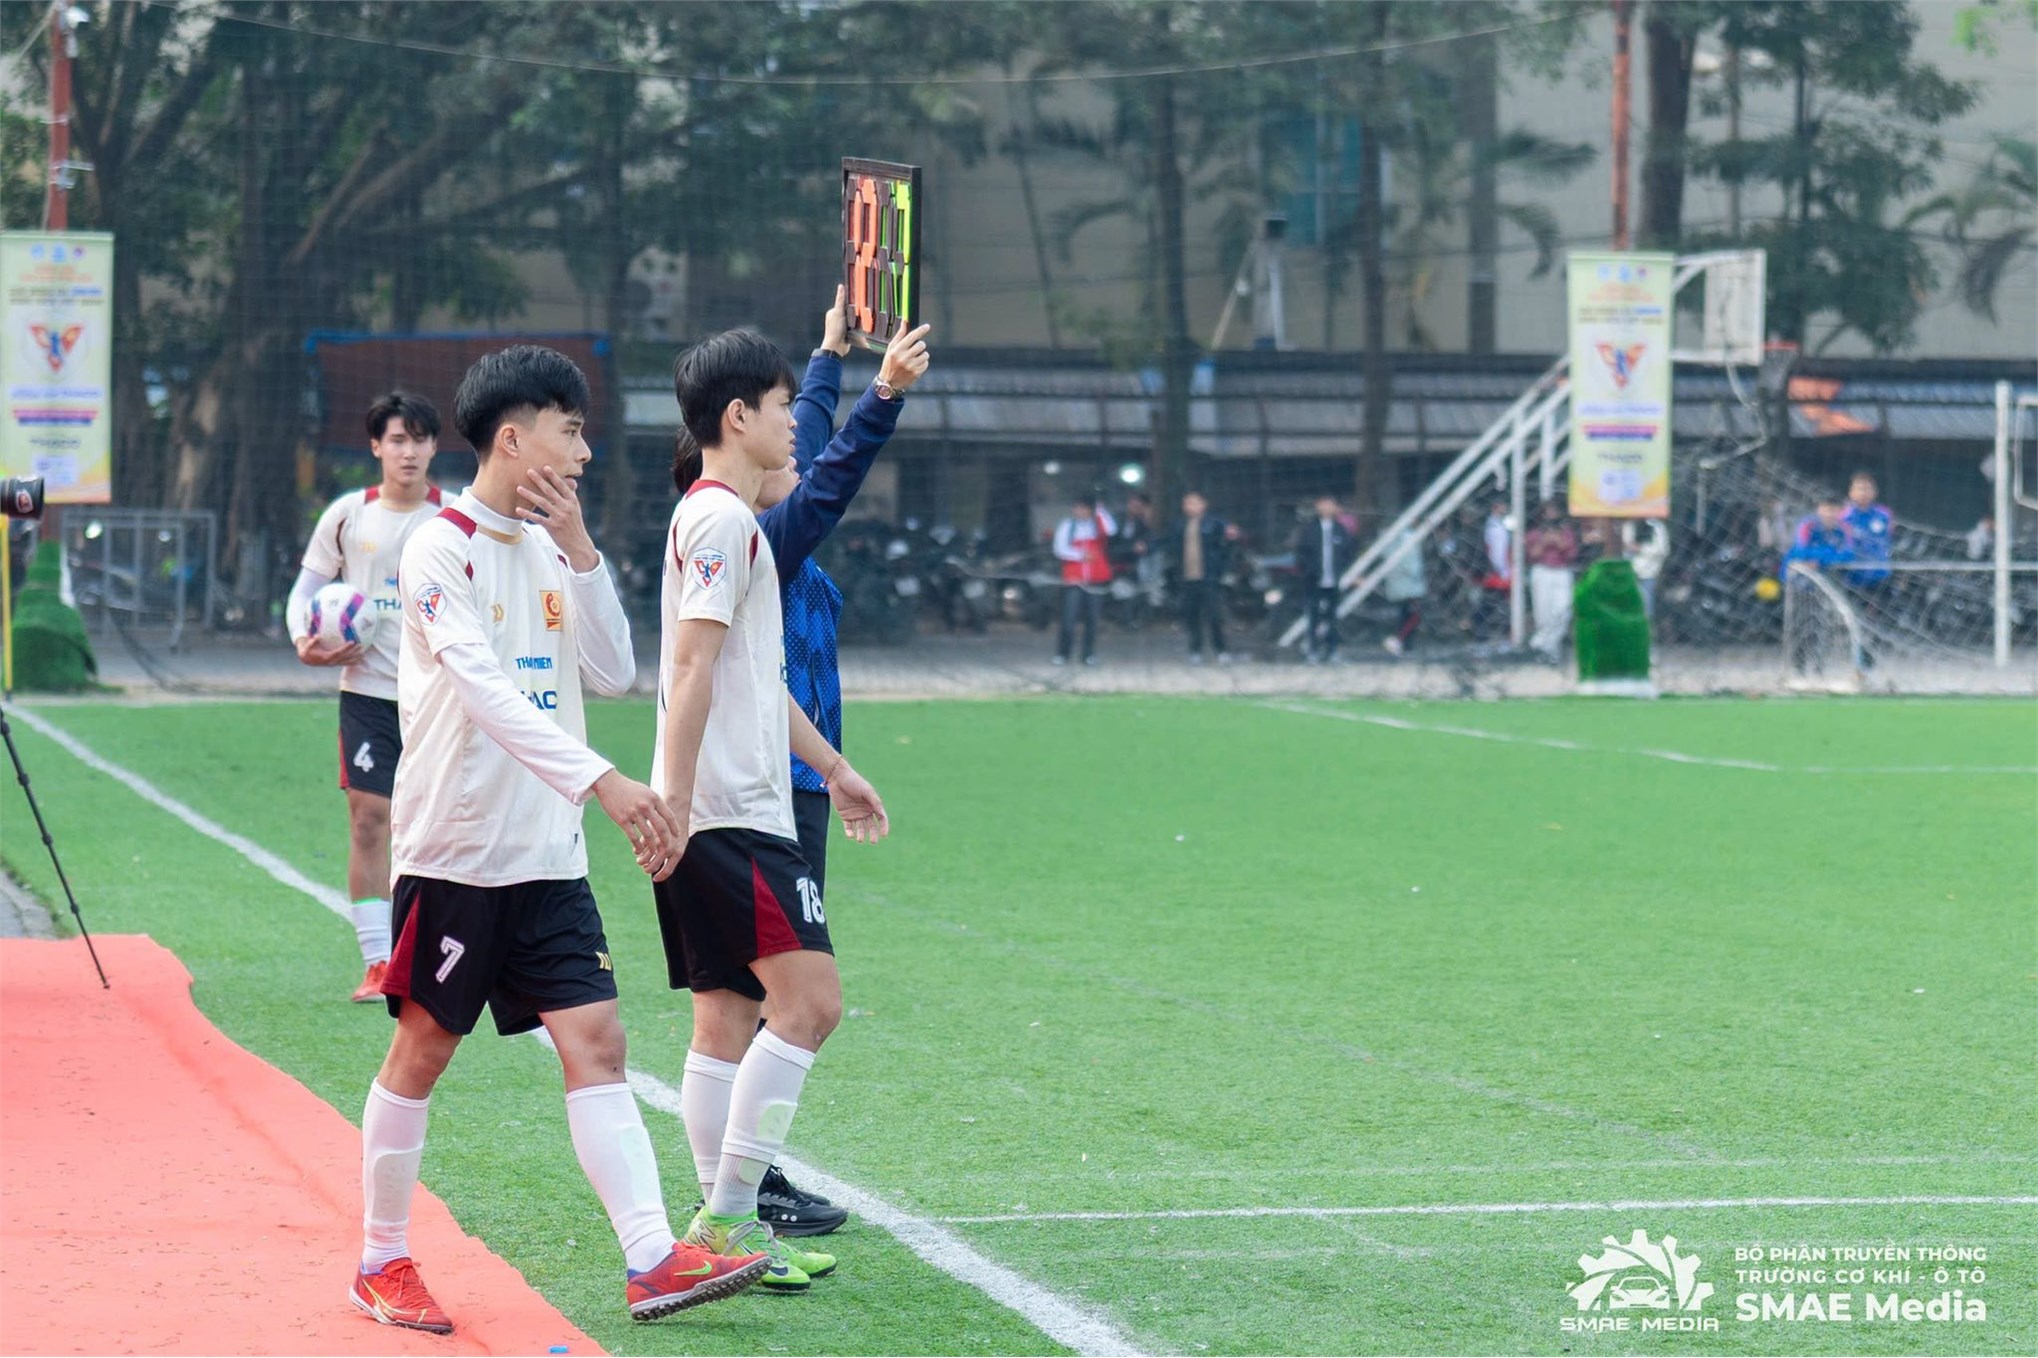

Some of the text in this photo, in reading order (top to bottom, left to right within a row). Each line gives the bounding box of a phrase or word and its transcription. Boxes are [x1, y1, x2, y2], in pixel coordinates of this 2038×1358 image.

[353, 741, 374, 773] 4
[796, 877, 826, 924] 18
[435, 935, 465, 984] 7
